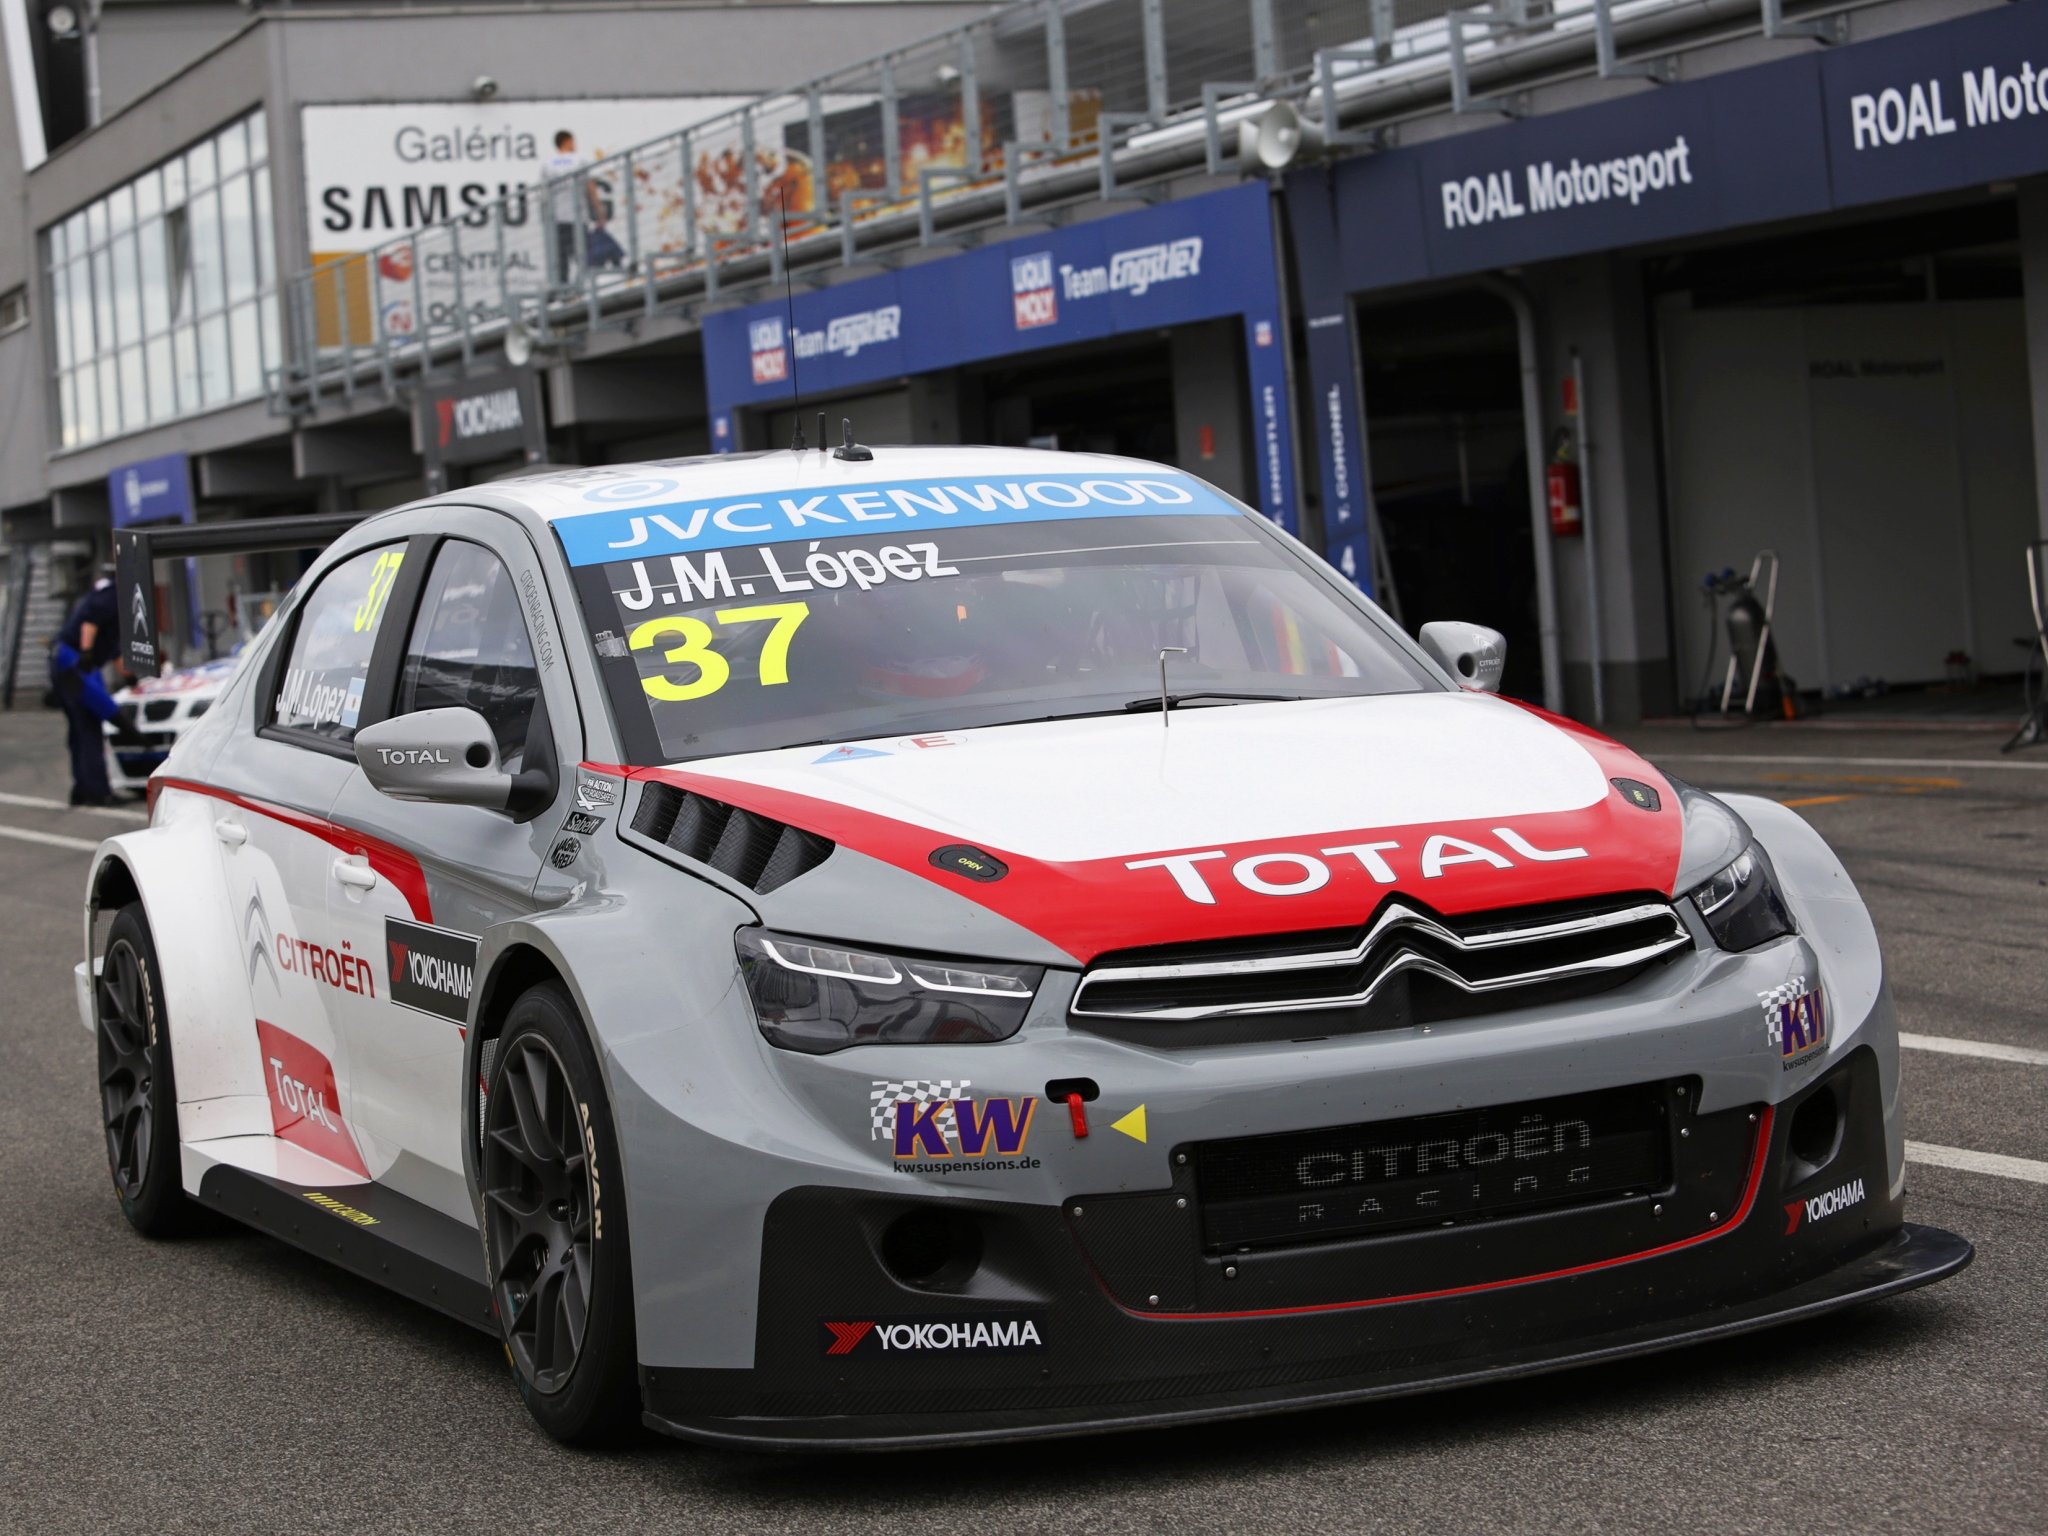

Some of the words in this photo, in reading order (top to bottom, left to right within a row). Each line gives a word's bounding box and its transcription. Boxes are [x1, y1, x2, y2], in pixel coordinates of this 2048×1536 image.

[395, 124, 538, 164] Galéria
[1850, 78, 1957, 151] ROAL
[322, 182, 614, 233] SAMSUG
[1441, 169, 1526, 229] ROAL
[1526, 135, 1693, 205] Motorsport
[1058, 264, 1109, 300] Team
[1109, 236, 1203, 297] Engstler
[788, 327, 826, 359] Team
[826, 305, 902, 357] Engstler
[1328, 384, 1348, 499] CORONEL
[607, 502, 774, 549] JVC
[785, 478, 1195, 528] KENWOOD
[353, 551, 405, 633] 37
[619, 554, 756, 612] J.M.
[757, 541, 961, 593] López
[520, 568, 555, 674] CITROENRACING.COM
[628, 601, 812, 702] 37
[302, 671, 347, 731] López
[377, 748, 450, 766] TOTAL
[567, 814, 598, 834] Sabelt
[957, 857, 984, 872] OPEN
[1125, 827, 1590, 905] TOTAL
[275, 931, 376, 999] CITROËN
[407, 949, 474, 999] YOKOHAMA
[1781, 987, 1827, 1057] KW
[269, 1057, 338, 1133] TOTAL
[894, 1097, 1037, 1160] KW
[579, 1102, 603, 1240] ADVAN
[893, 1156, 1042, 1175] kwsuspensions.de
[1297, 1114, 1590, 1185] CITROËN
[1805, 1178, 1866, 1223] YOKOHAMA
[874, 1320, 1042, 1350] YOKOHAMA
